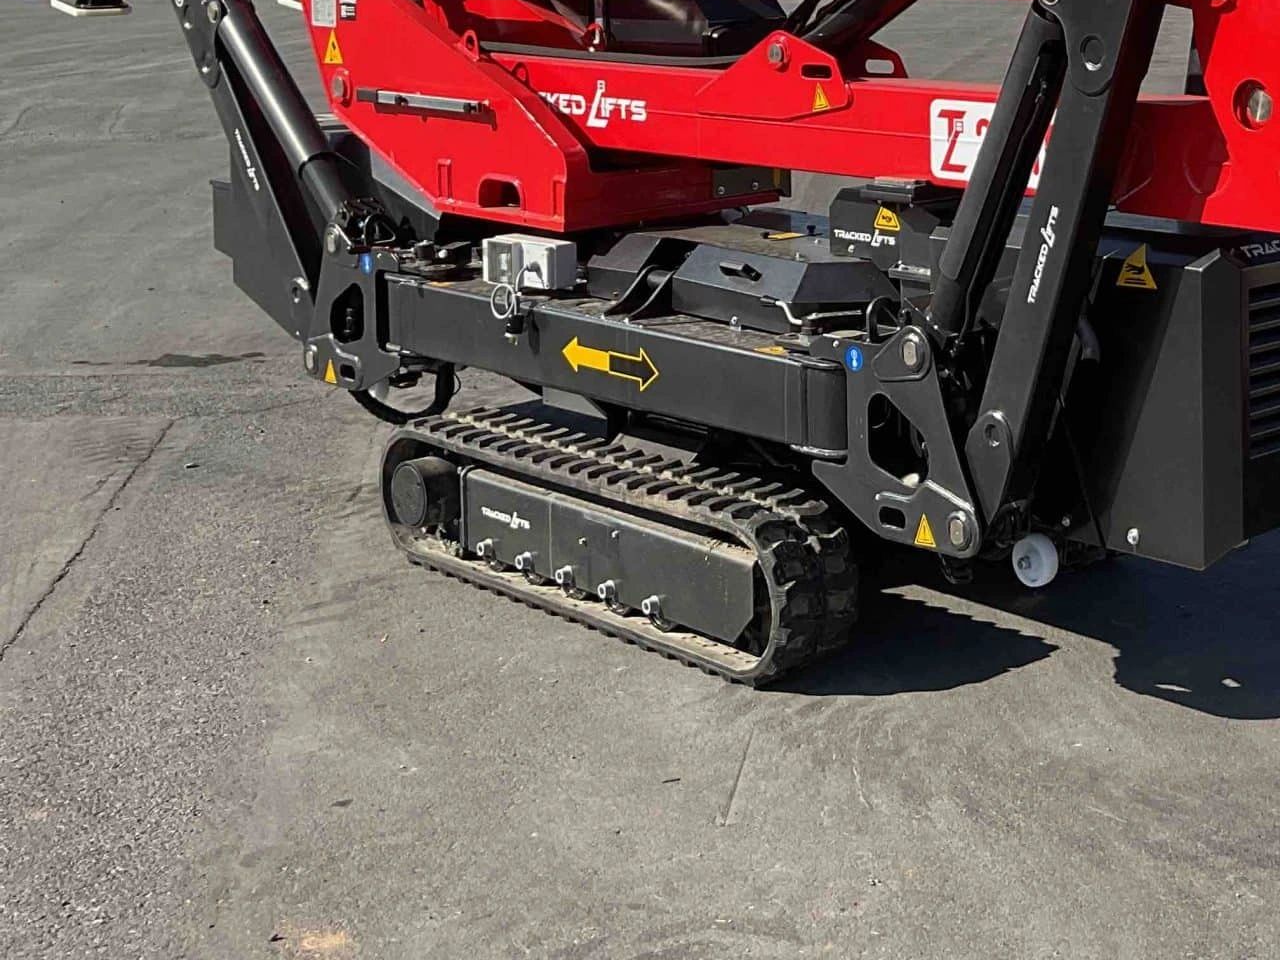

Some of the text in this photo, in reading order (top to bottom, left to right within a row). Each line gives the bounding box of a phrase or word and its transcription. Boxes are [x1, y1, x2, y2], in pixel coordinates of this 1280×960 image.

[586, 80, 648, 128] LIFTS
[833, 229, 896, 247] TRACKED LIFTS
[1027, 205, 1059, 303] TRACKED LIFTS
